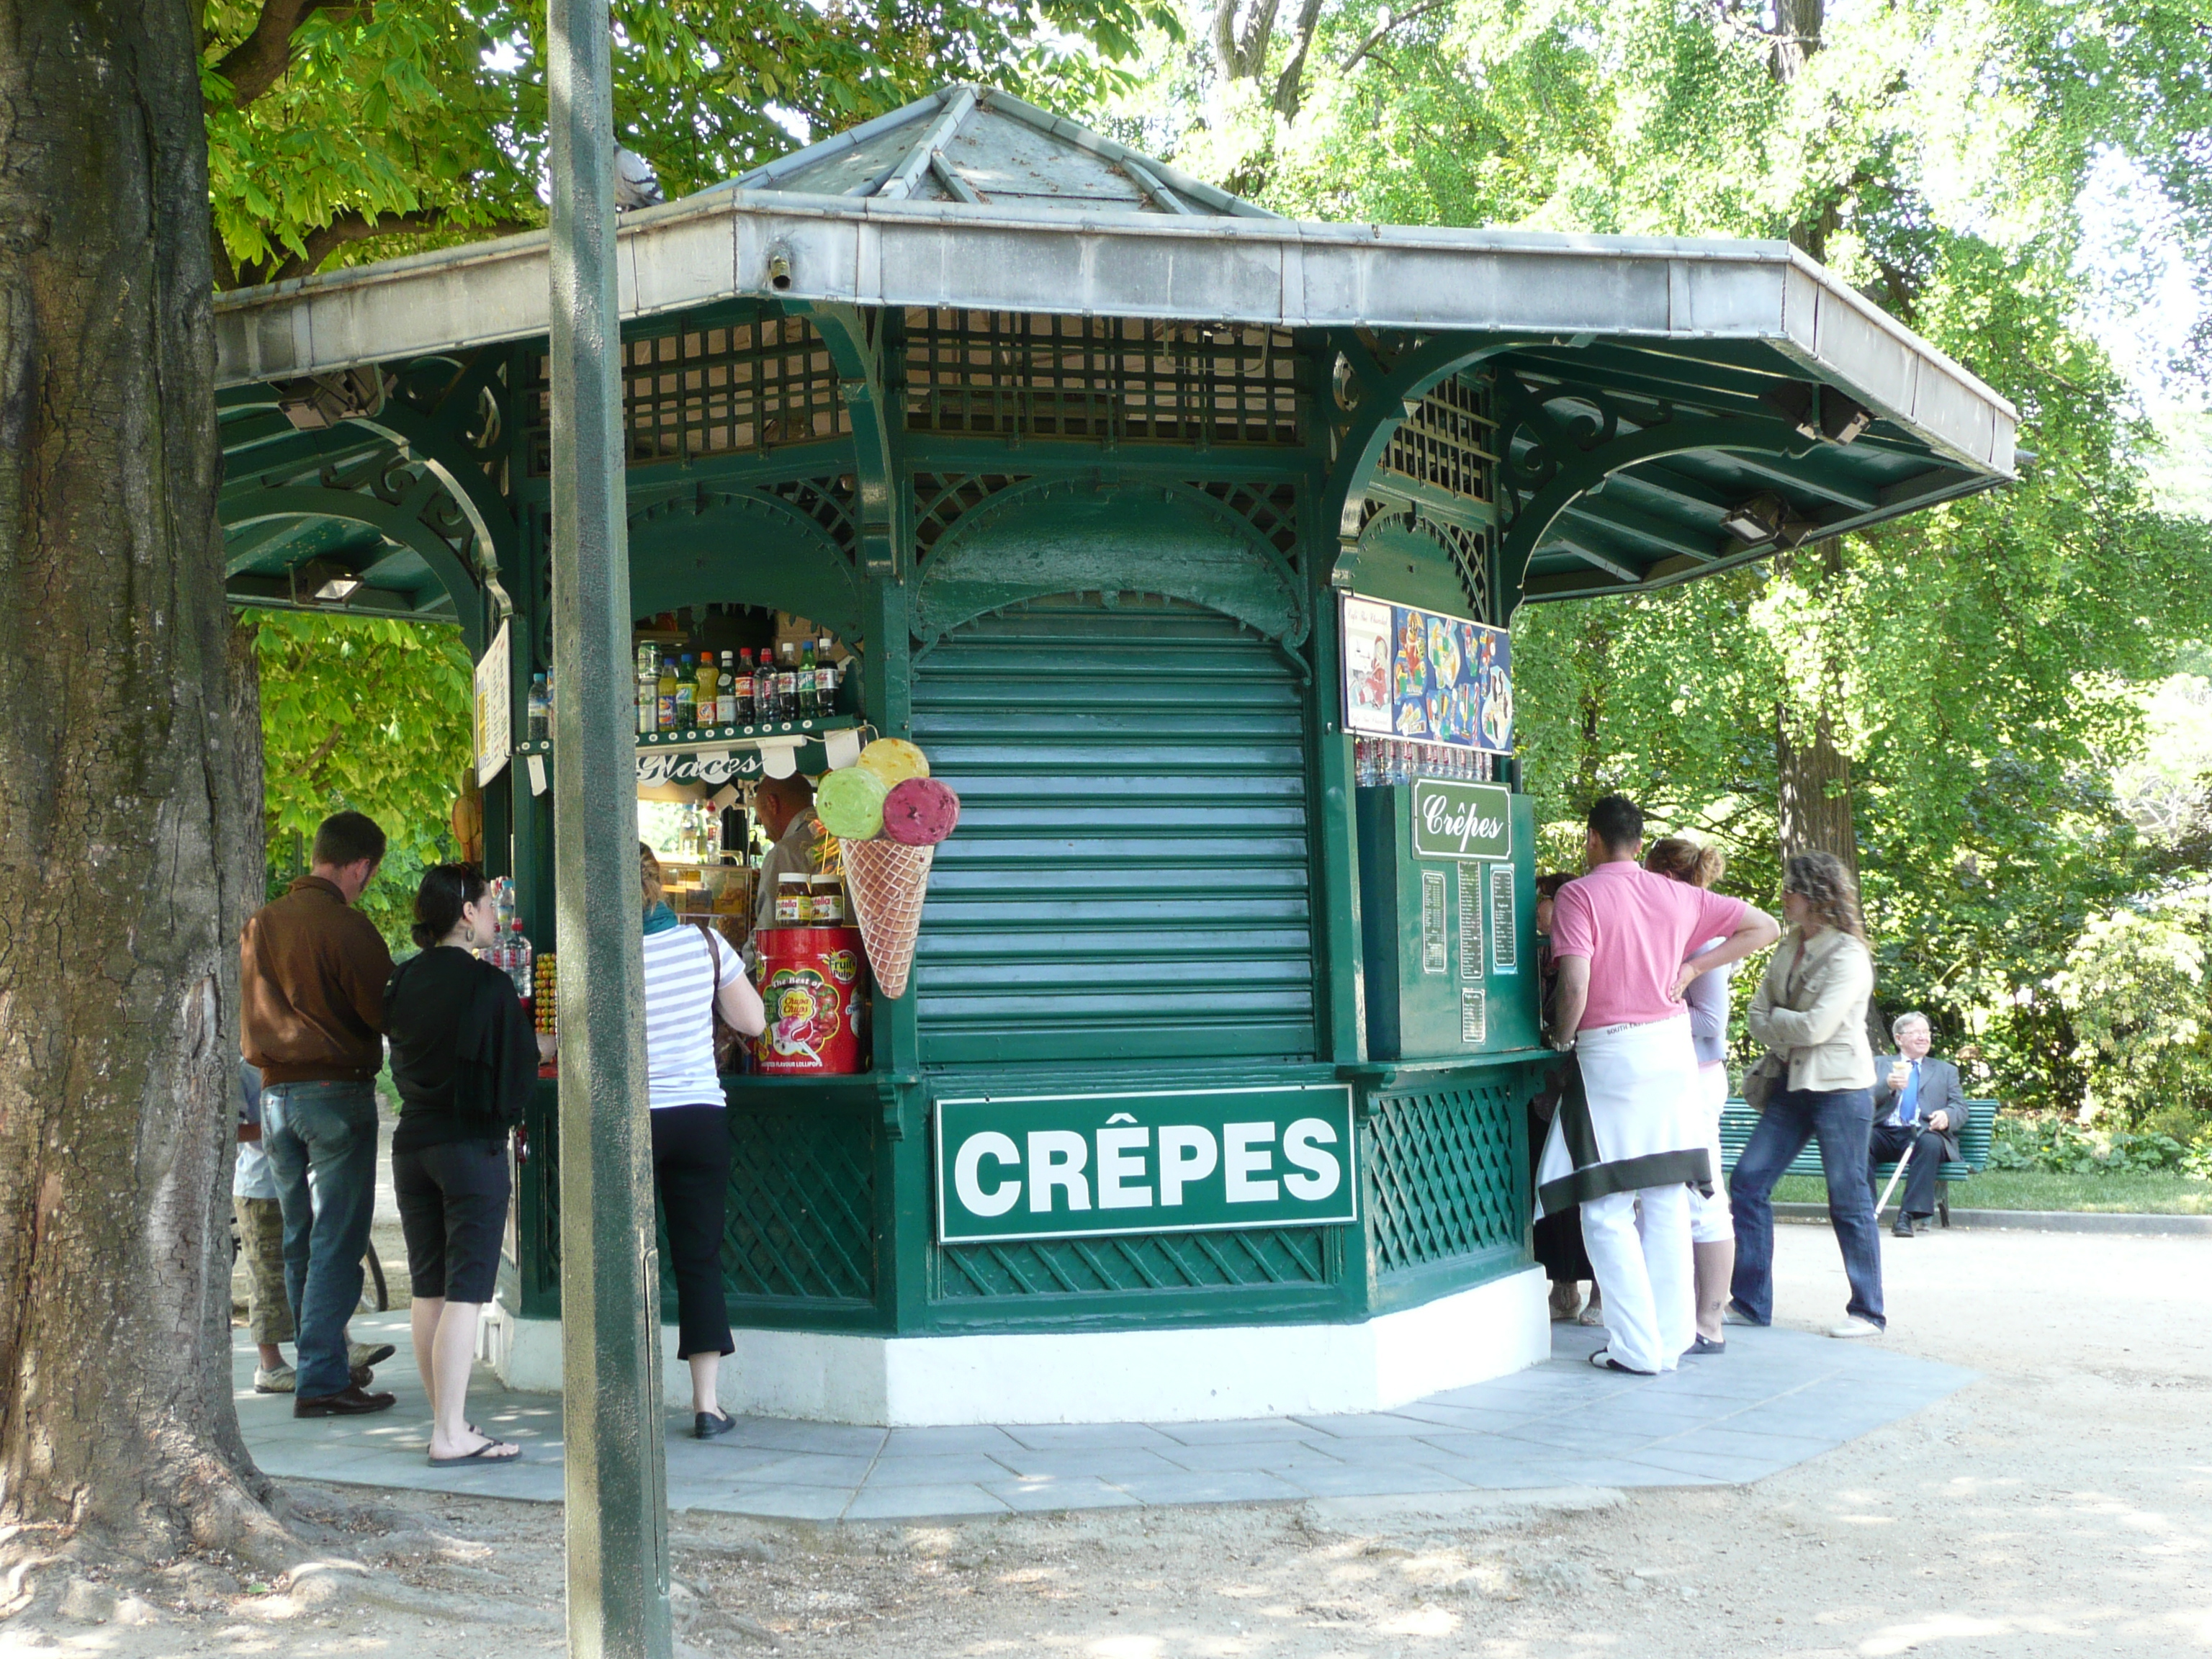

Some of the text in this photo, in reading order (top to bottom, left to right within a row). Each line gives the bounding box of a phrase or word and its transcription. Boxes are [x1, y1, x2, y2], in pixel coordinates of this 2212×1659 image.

[637, 755, 768, 781] Glaces
[1423, 794, 1504, 853] Crêpes
[829, 958, 852, 969] Fruit
[773, 976, 824, 990] The Best of
[784, 996, 809, 1007] Chupa
[783, 1004, 809, 1015] Chups
[1606, 1023, 1627, 1035] SOUTH
[954, 1112, 1341, 1217] CRÊPES
